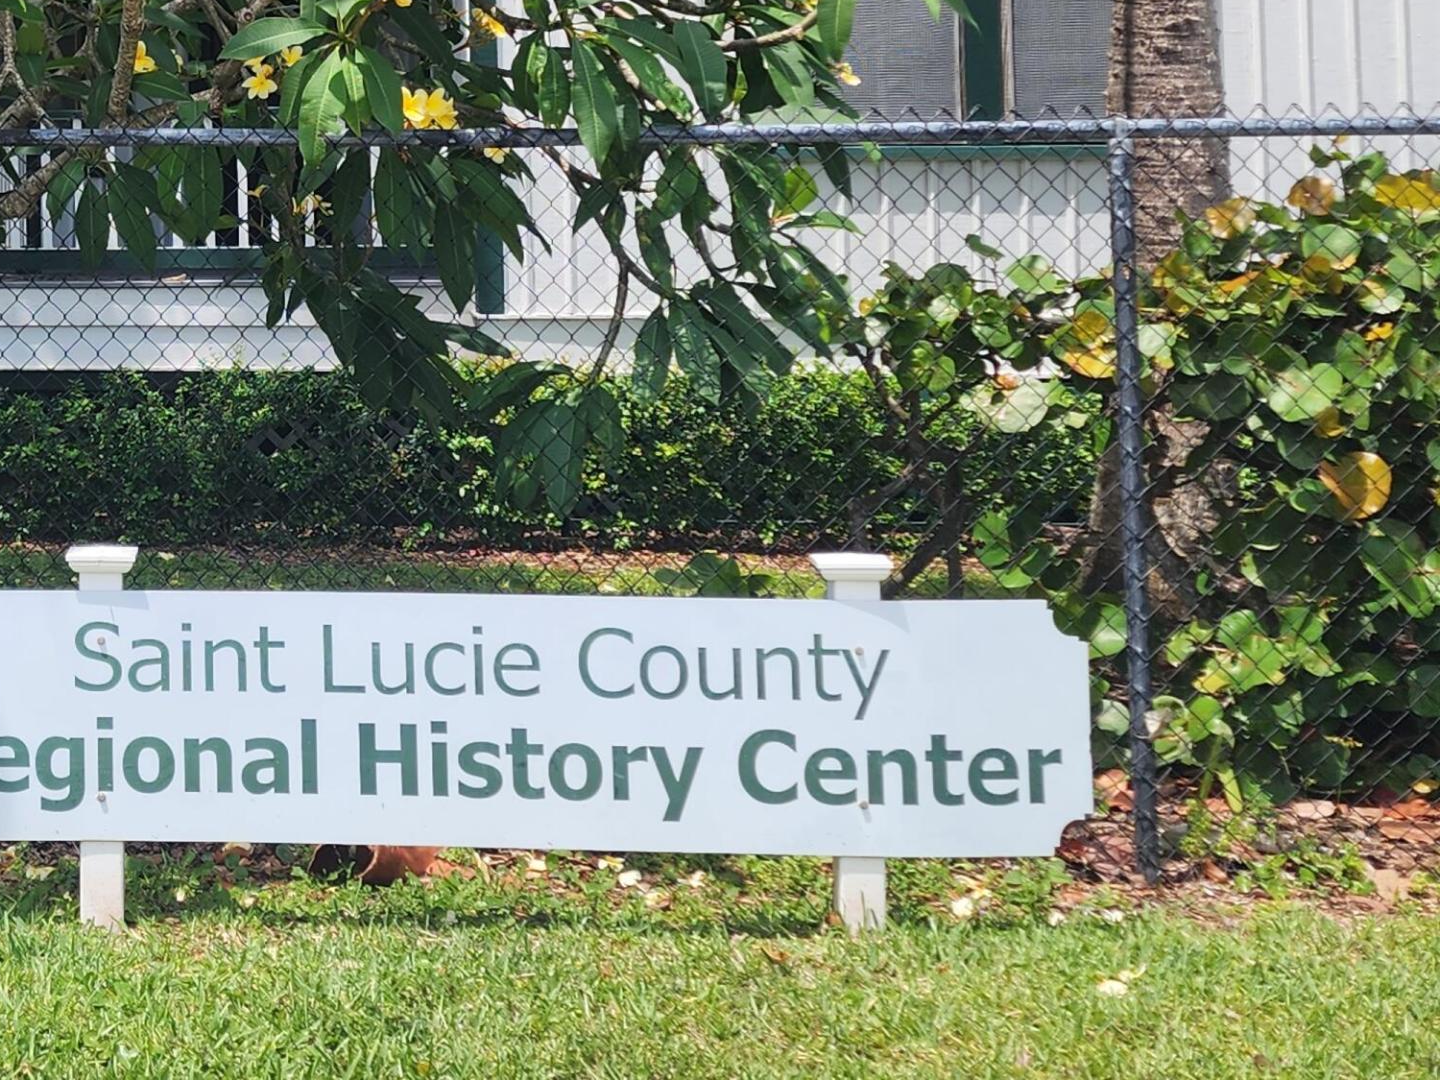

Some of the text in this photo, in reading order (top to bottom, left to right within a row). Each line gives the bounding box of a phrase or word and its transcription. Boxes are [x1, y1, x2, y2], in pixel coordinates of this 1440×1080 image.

[73, 622, 890, 720] Saint Lucie County
[358, 722, 703, 822] History
[738, 729, 1064, 806] Center
